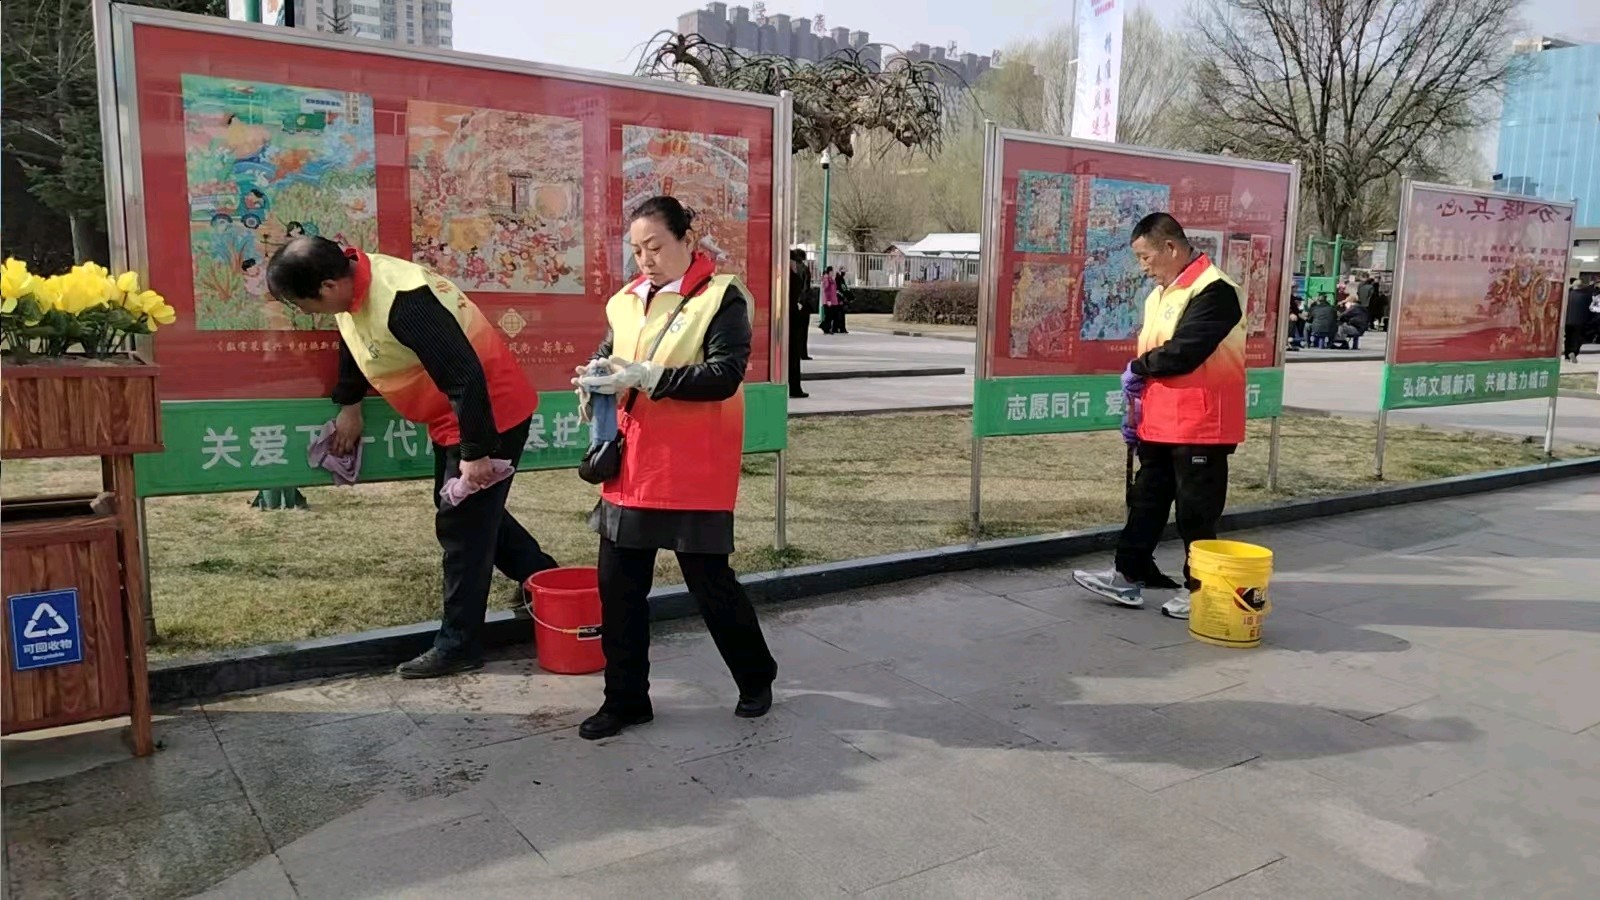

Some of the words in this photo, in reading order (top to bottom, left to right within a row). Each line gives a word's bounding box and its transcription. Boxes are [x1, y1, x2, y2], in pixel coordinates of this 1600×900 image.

[1402, 374, 1475, 397] 弘扬文明新风
[1484, 369, 1549, 393] 共建魅力城市
[1007, 391, 1091, 420] 志愿同行
[22, 639, 73, 655] 可回收物
